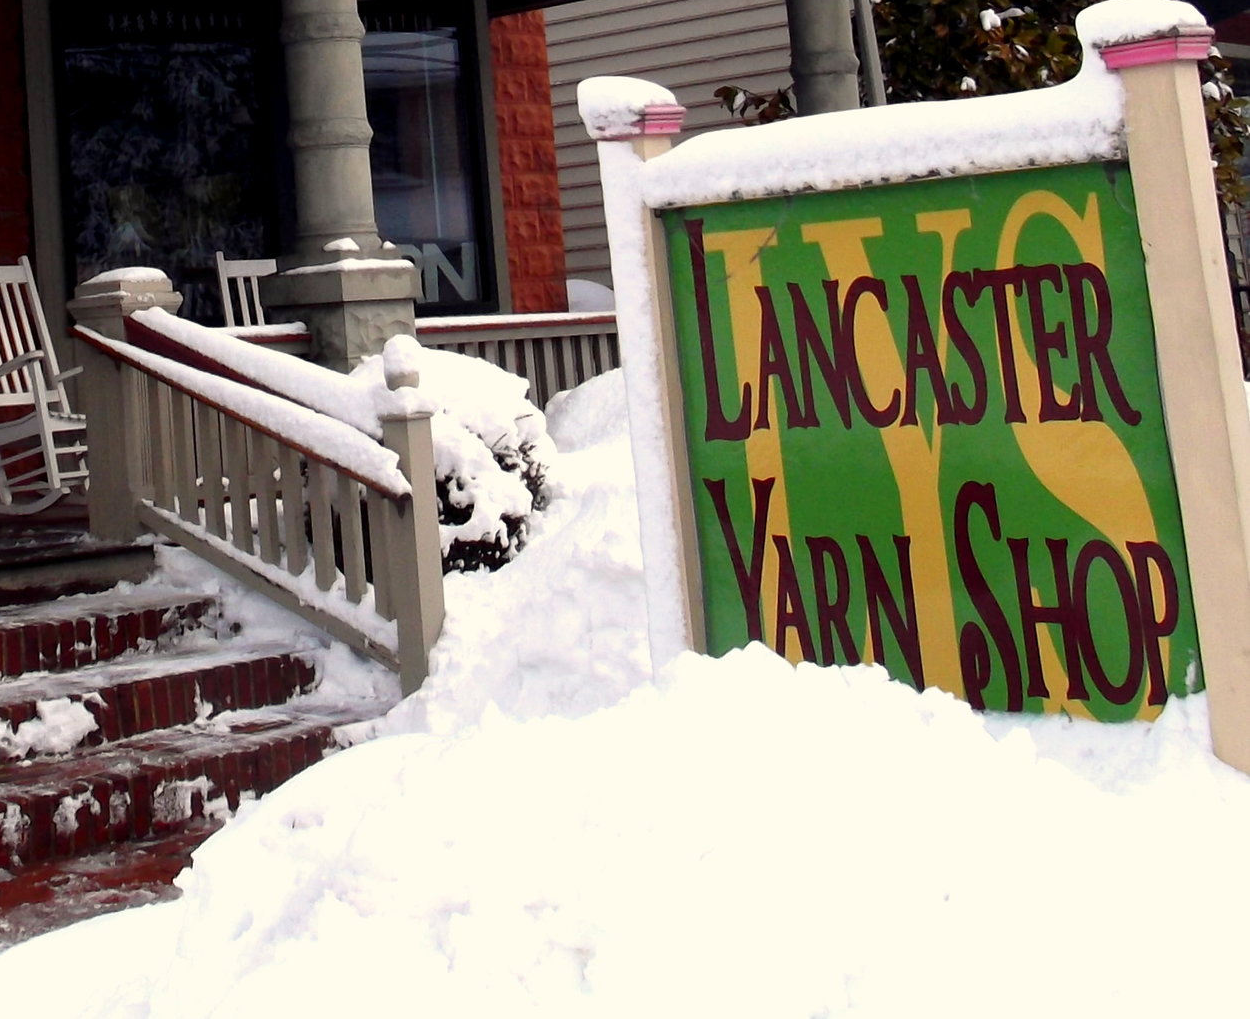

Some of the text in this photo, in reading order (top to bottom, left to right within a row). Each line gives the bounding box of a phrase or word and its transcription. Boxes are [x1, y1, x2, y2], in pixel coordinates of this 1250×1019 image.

[683, 218, 1142, 442] LANCASTER
[703, 189, 1172, 723] LYS
[702, 477, 1180, 713] YARN SHOP
